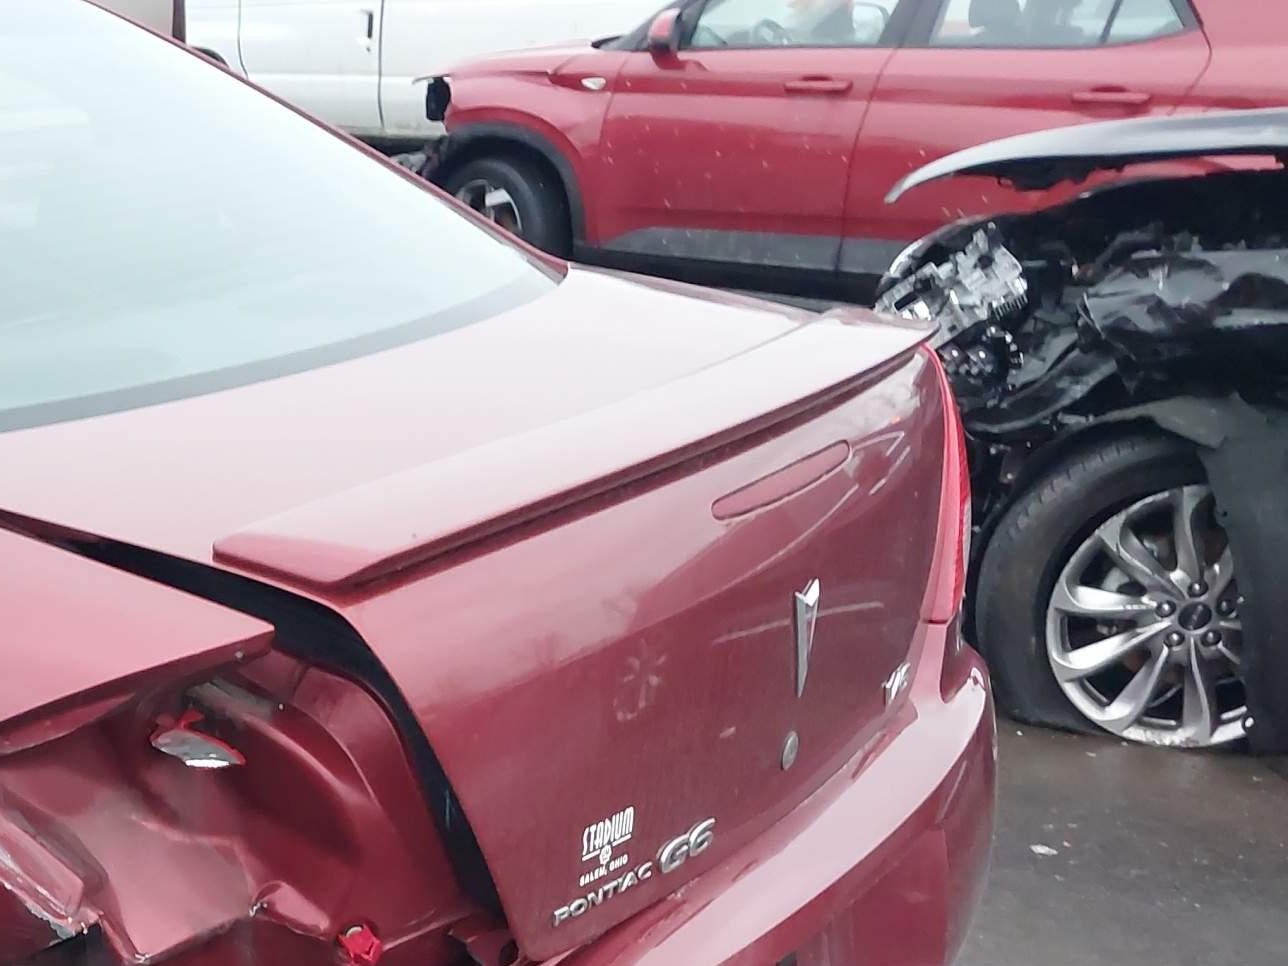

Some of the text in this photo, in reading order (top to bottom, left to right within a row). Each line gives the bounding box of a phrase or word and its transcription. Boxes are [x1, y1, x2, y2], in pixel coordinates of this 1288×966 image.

[582, 806, 634, 855] STADIUM
[553, 818, 716, 927] PONTIAC G6
[609, 854, 629, 872] OHIO
